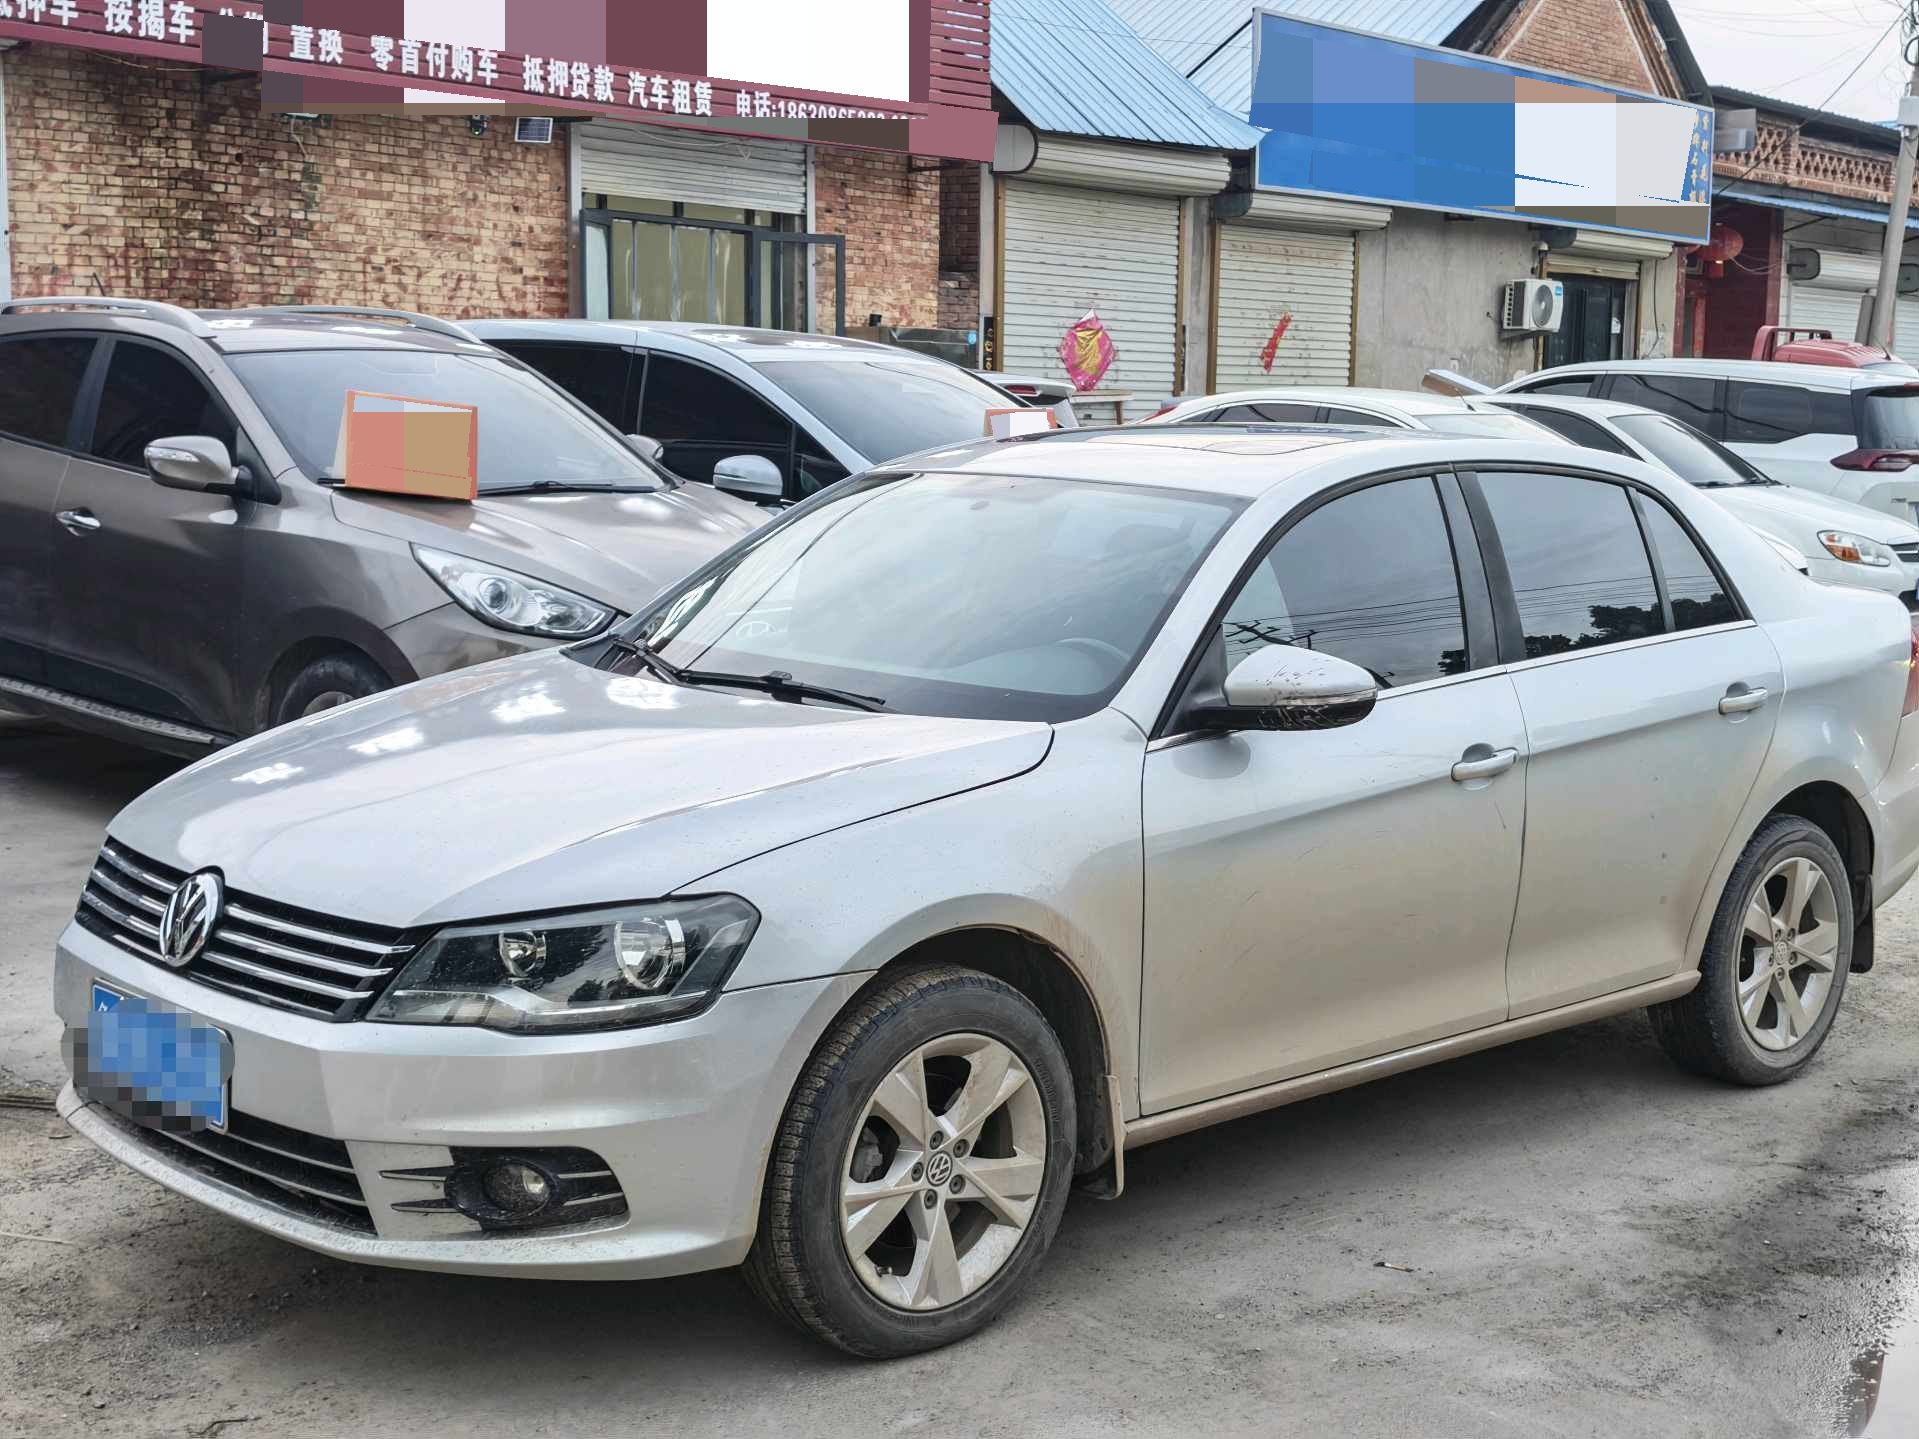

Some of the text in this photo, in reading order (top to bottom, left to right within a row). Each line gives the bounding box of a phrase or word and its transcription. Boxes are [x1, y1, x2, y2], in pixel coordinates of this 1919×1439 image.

[104, 0, 196, 43] 按揭车
[289, 25, 343, 64] 置换
[370, 35, 499, 85] 零首付购车
[522, 54, 615, 103] 抵押贷款
[627, 71, 713, 117] 汽车租赁
